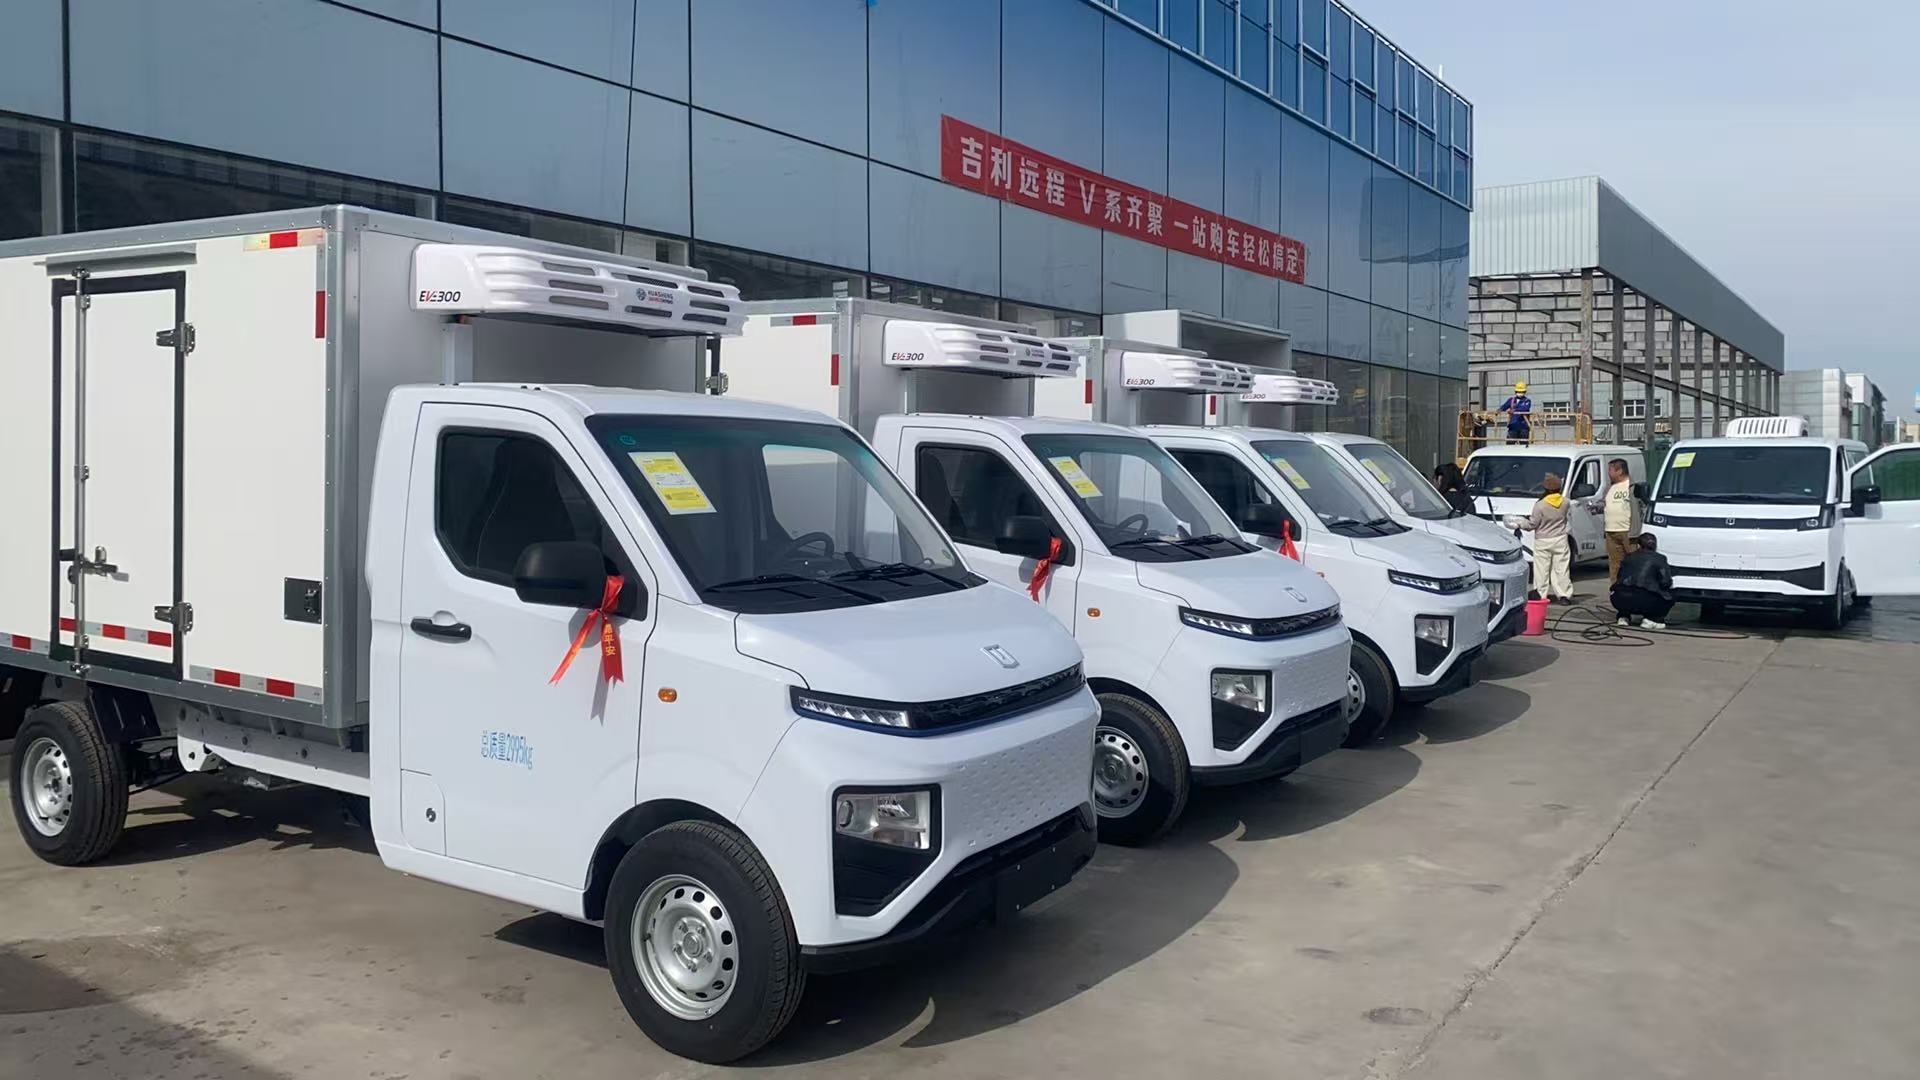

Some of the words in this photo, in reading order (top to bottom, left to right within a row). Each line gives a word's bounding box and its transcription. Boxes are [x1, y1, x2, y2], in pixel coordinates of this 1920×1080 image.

[960, 136, 1065, 207] 吉利远程
[1173, 215, 1299, 275] 一站购车轻松搞定
